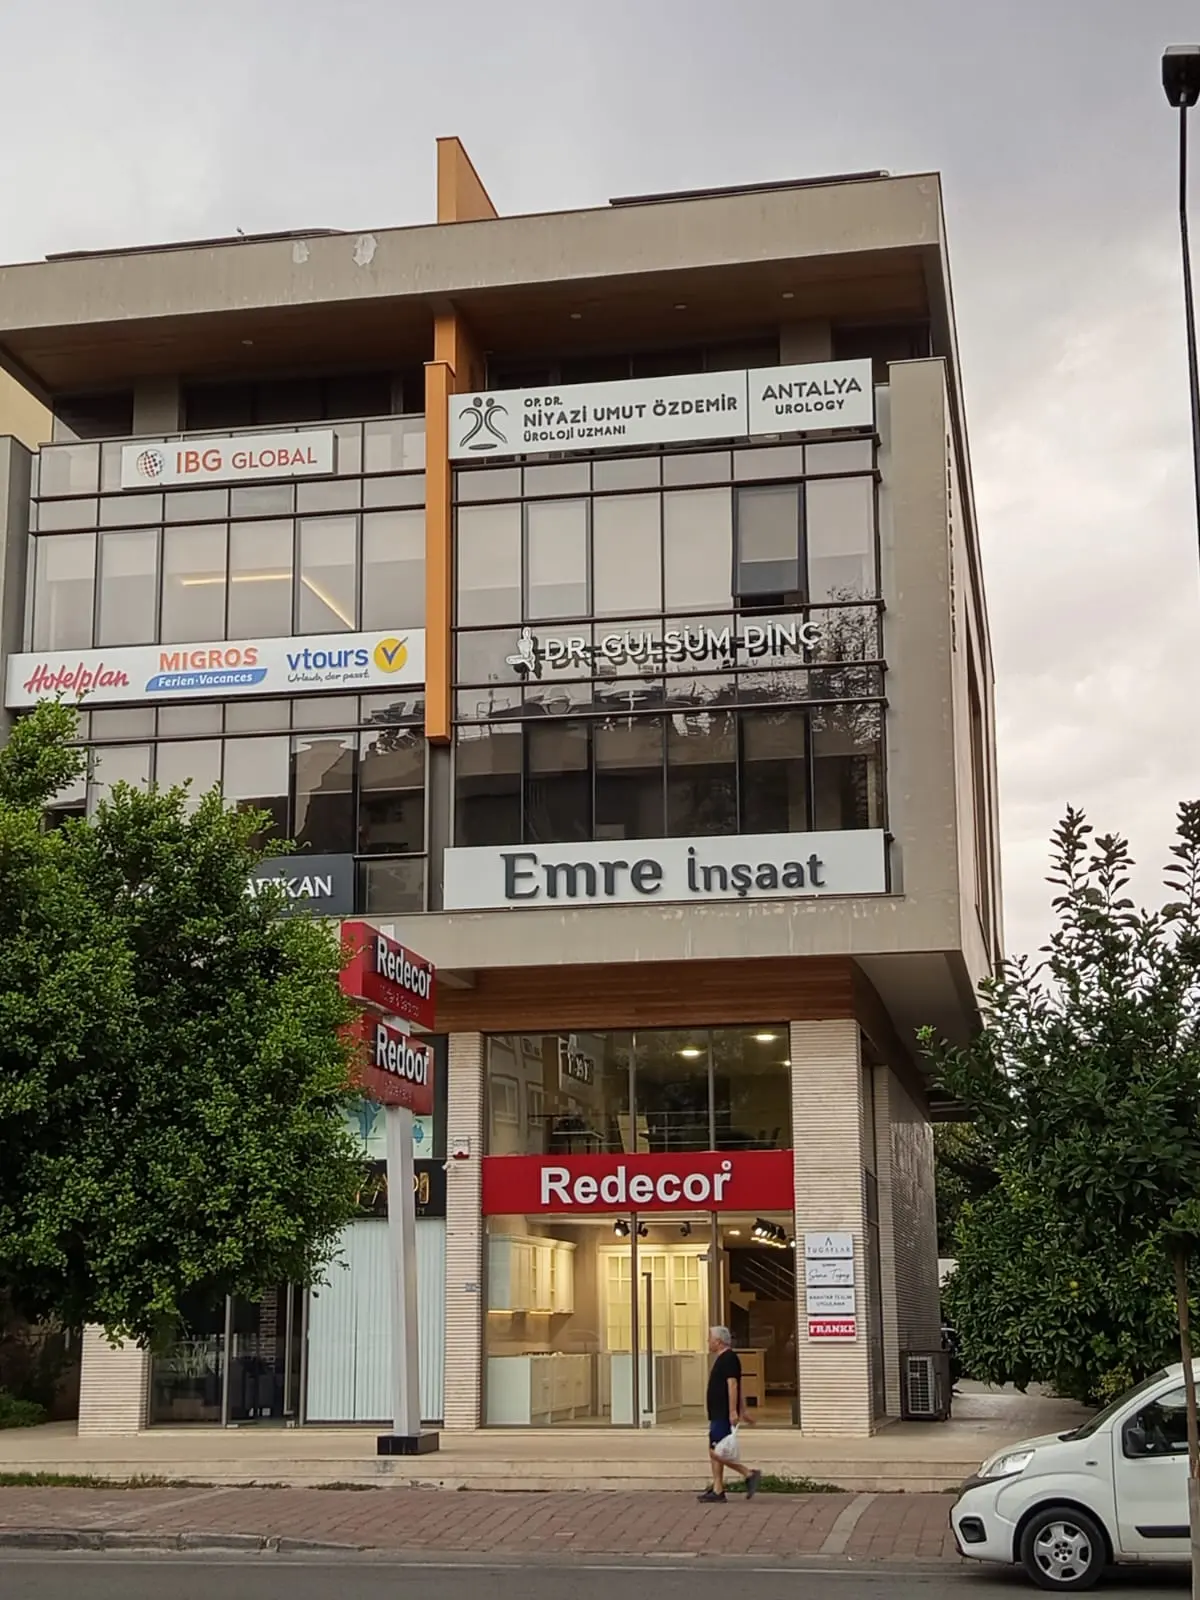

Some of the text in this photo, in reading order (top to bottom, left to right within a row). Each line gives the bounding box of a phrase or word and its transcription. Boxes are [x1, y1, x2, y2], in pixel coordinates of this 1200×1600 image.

[524, 396, 563, 408] OP. DR.
[762, 377, 862, 401] ANTALYA
[523, 394, 738, 428] NİYAZİ UMUT ÖZDEMİR
[775, 399, 844, 415] UROLOGY
[577, 425, 626, 438] UZMANI
[176, 447, 317, 473] IBG GLOBAL
[544, 620, 822, 661] DR. GÜLSÜM DİNÇ
[159, 647, 259, 672] MIGROS
[286, 648, 369, 671] vtours
[23, 662, 129, 696] Hotelplan
[499, 846, 826, 900] Emre İnşaat
[377, 934, 432, 1000] Redecor
[377, 1023, 429, 1086] Redoor
[540, 1160, 732, 1205] Redecor
[810, 1324, 855, 1333] FRANKE
